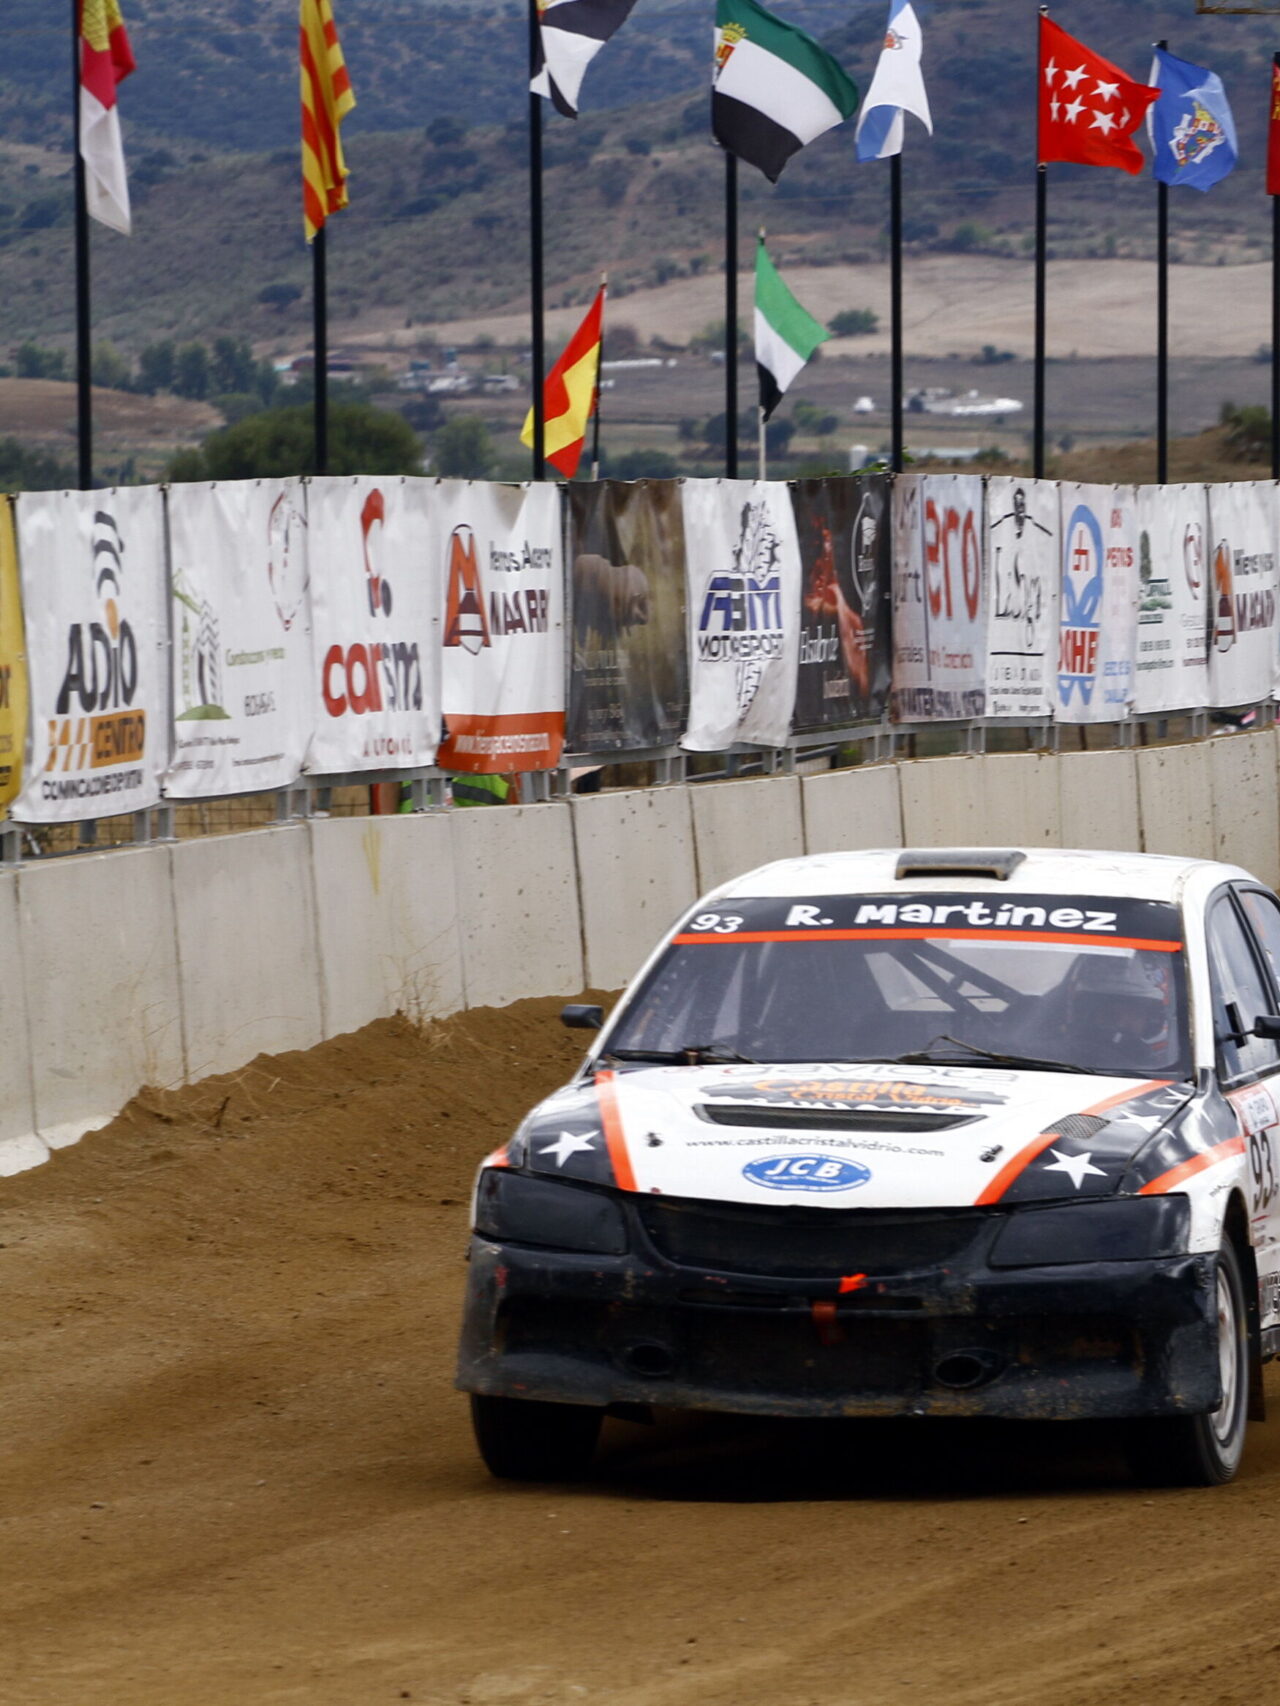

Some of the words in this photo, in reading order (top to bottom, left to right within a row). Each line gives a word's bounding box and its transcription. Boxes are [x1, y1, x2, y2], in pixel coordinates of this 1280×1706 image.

[691, 914, 744, 933] 93
[785, 905, 833, 926] R.
[686, 1134, 945, 1157] www.castillacristalvidrio.com
[764, 1159, 843, 1178] JCB
[1250, 1129, 1274, 1213] 93
